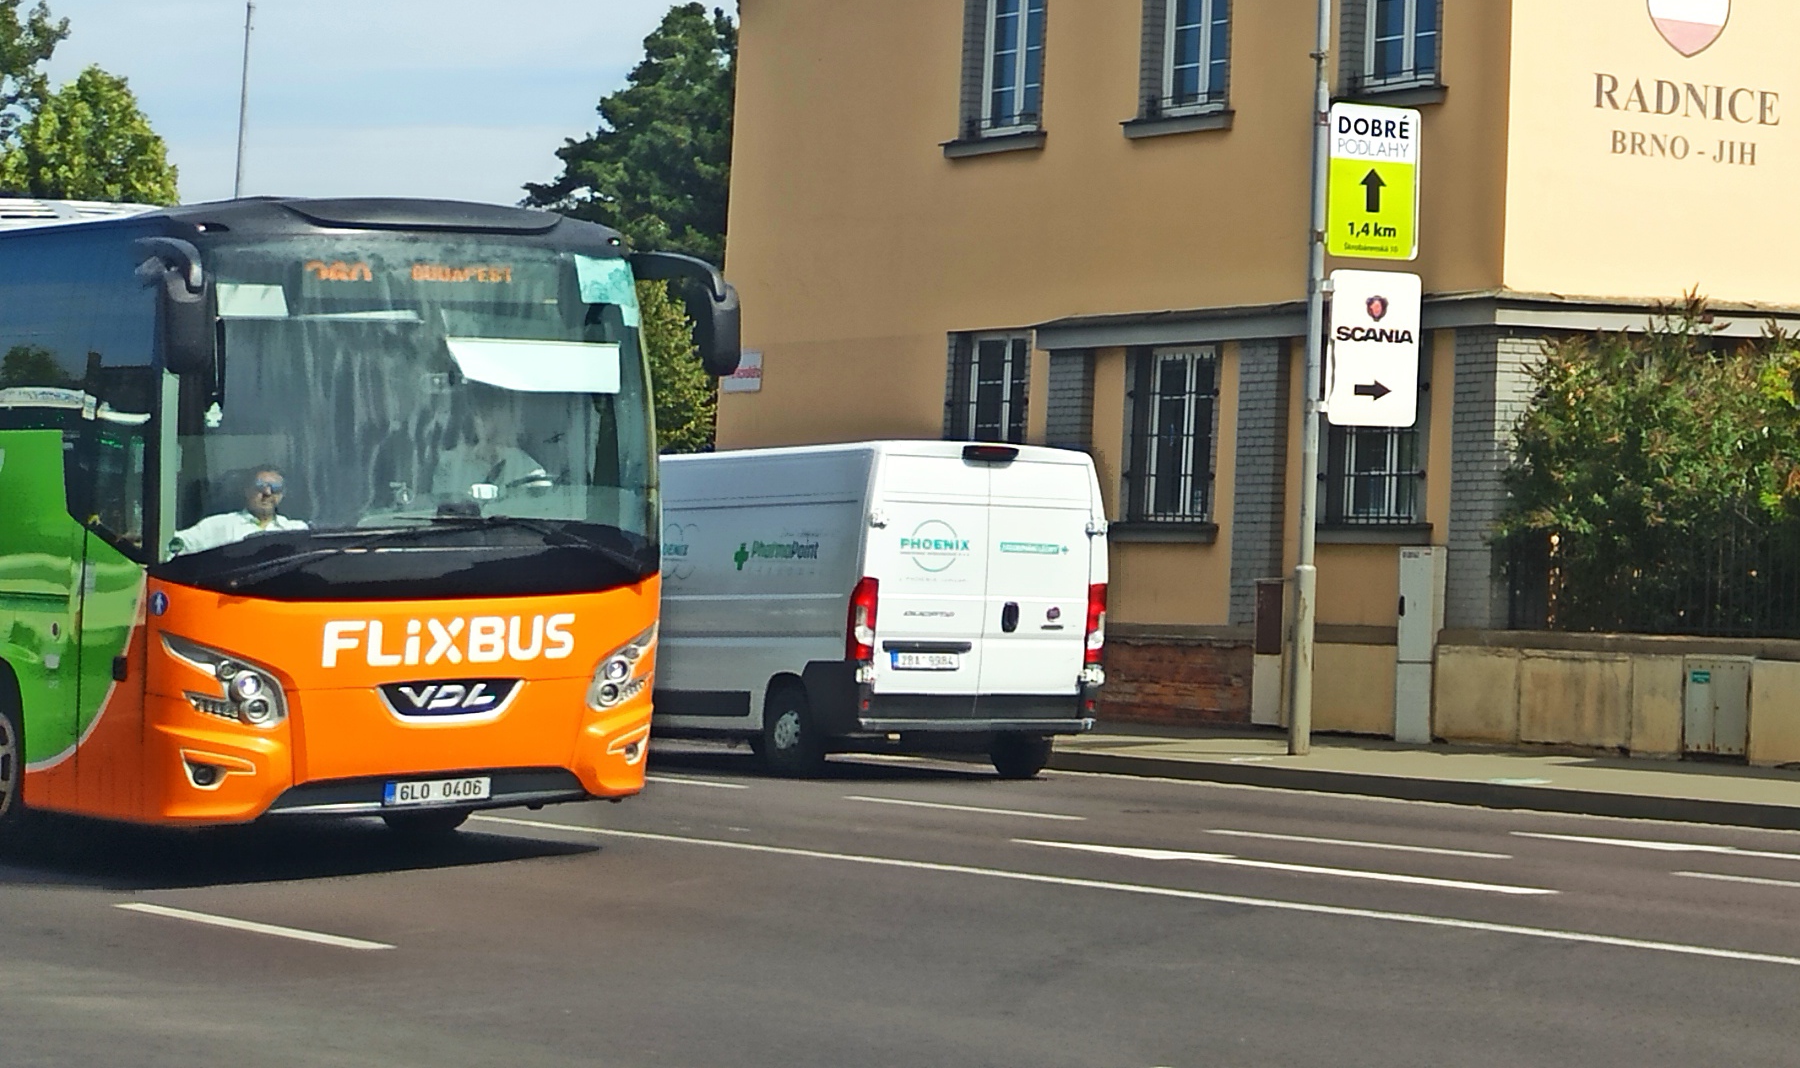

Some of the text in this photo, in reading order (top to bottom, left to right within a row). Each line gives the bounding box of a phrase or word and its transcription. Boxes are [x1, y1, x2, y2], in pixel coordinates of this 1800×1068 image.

[1593, 72, 1781, 127] RADNICE
[1338, 114, 1410, 140] DOBRÉ
[1337, 137, 1409, 158] PODLAHY
[1610, 129, 1690, 161] BRNO
[1712, 139, 1757, 167] JIH
[1348, 221, 1396, 241] 1,4 km
[1335, 326, 1414, 345] SCANIA
[899, 537, 970, 551] PHOENIX
[398, 682, 497, 711] VDL
[442, 779, 483, 798] 0406
